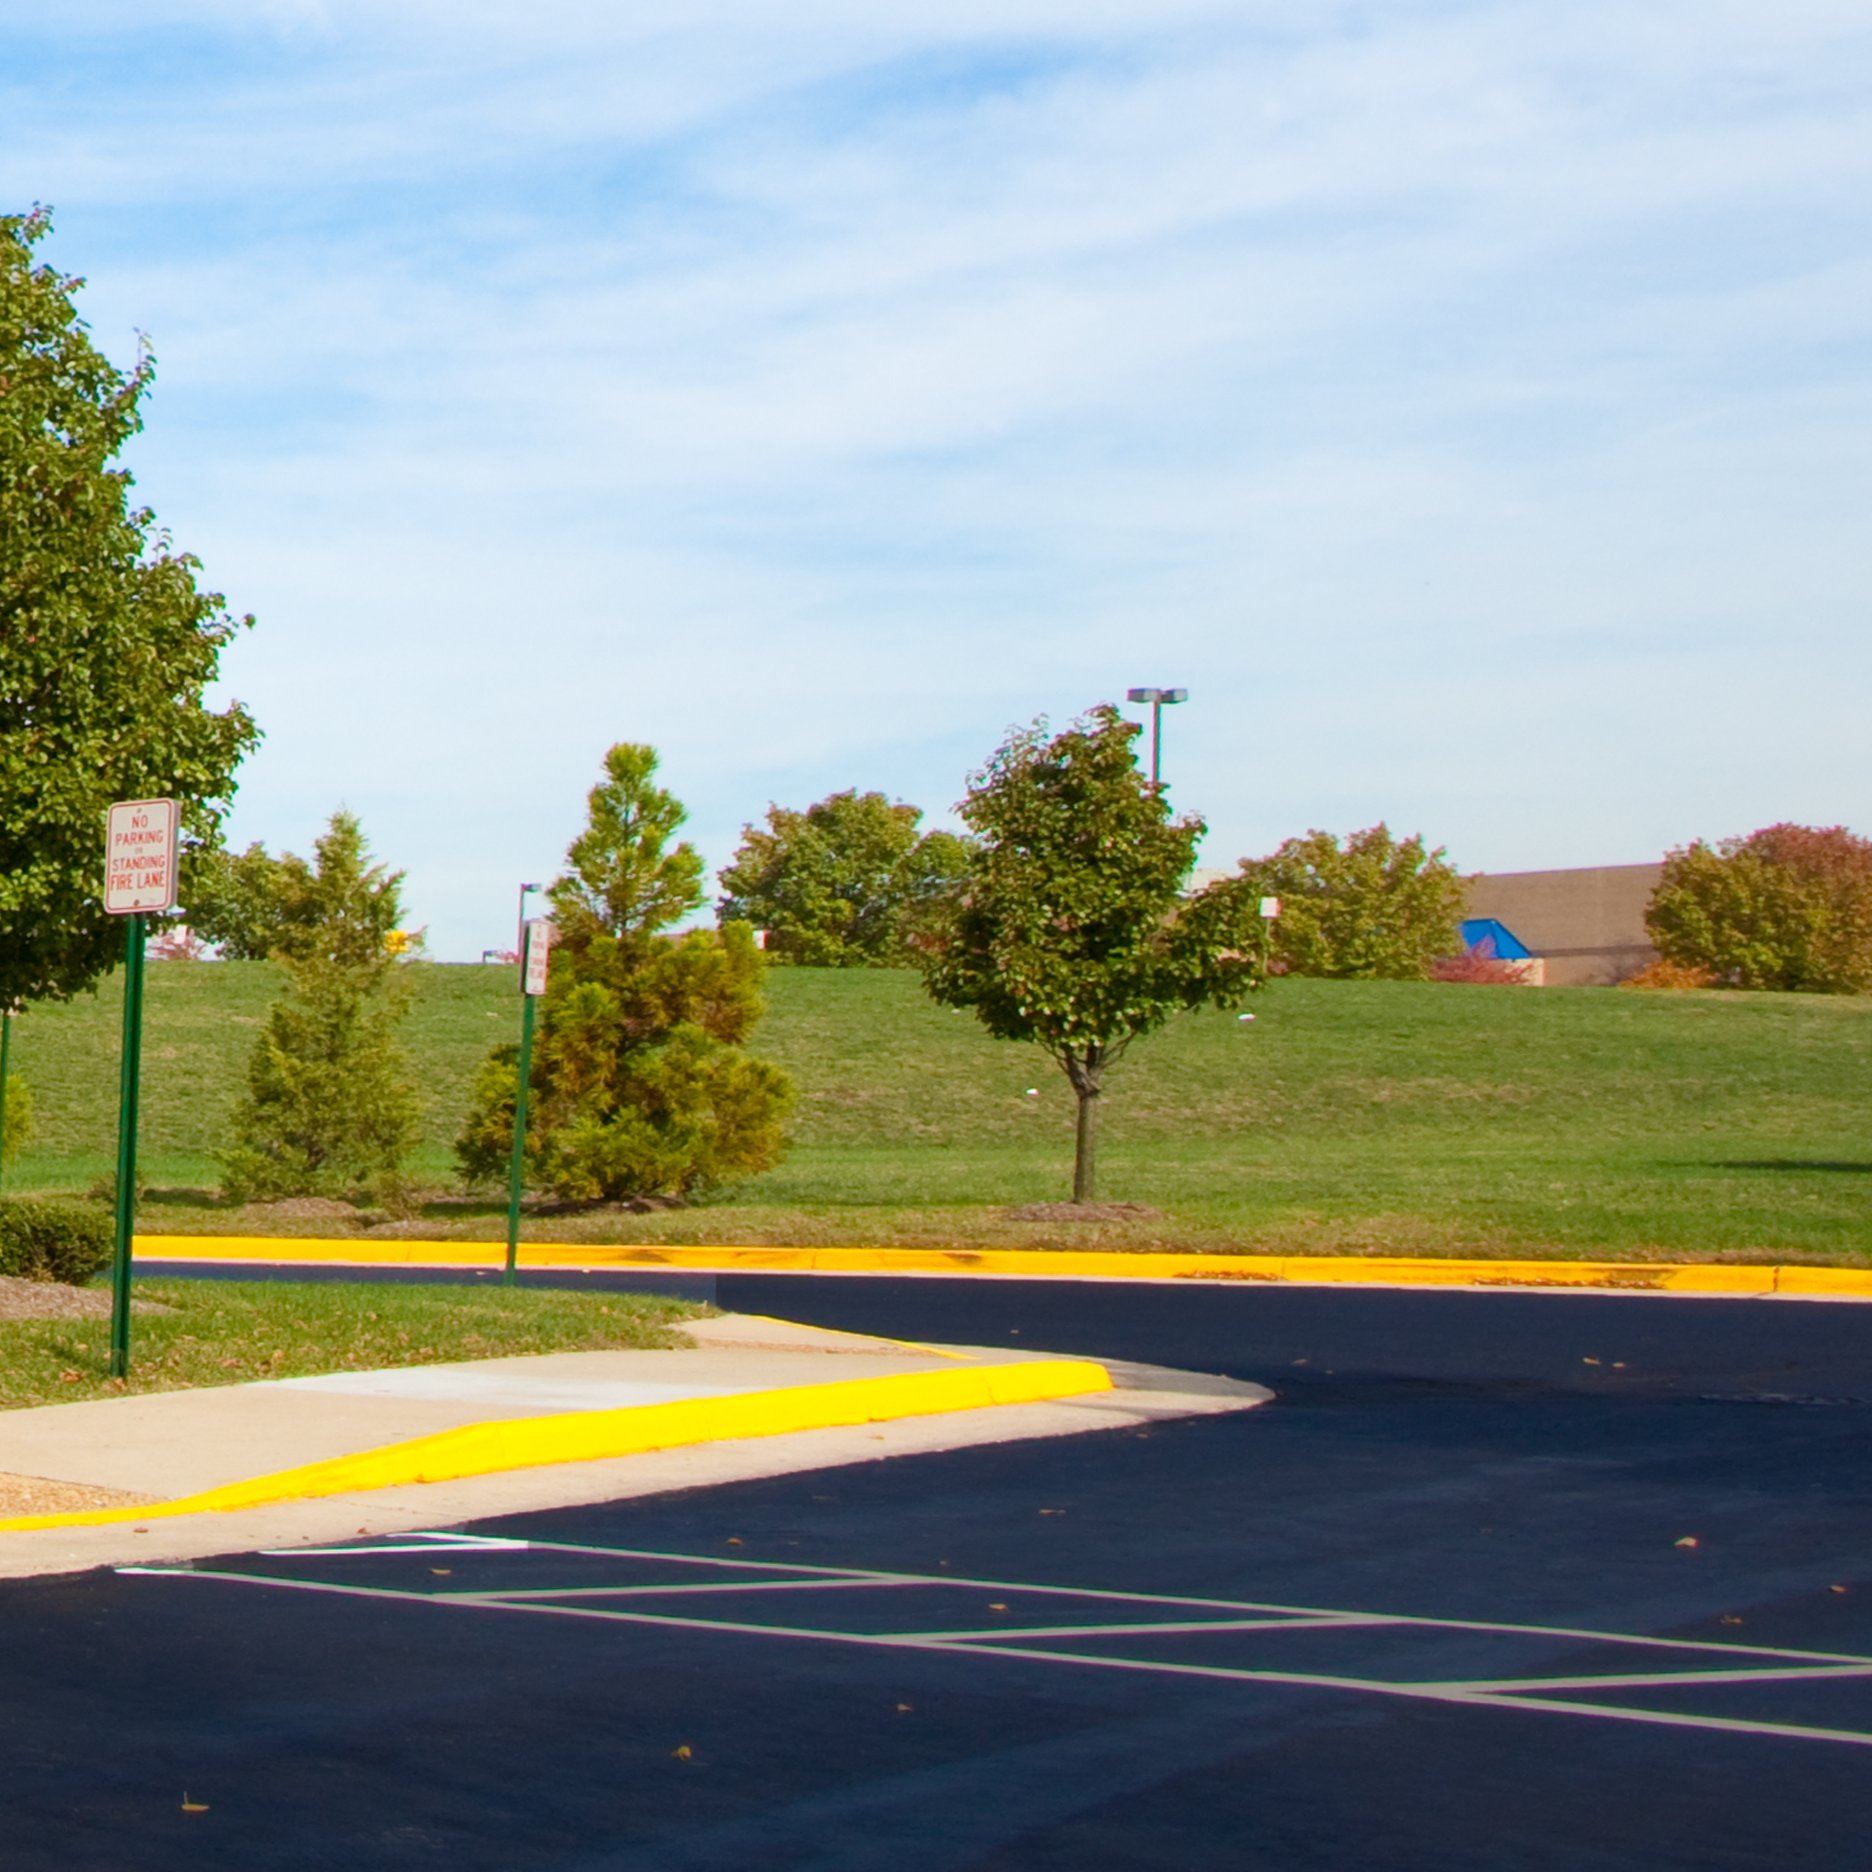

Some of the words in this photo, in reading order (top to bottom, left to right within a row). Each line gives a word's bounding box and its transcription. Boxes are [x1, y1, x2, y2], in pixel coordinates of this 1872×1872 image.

[131, 815, 148, 828] NO
[115, 830, 163, 846] PARKING
[112, 855, 165, 871] STANDING
[110, 873, 133, 891] FIRE
[137, 871, 165, 889] LANE
